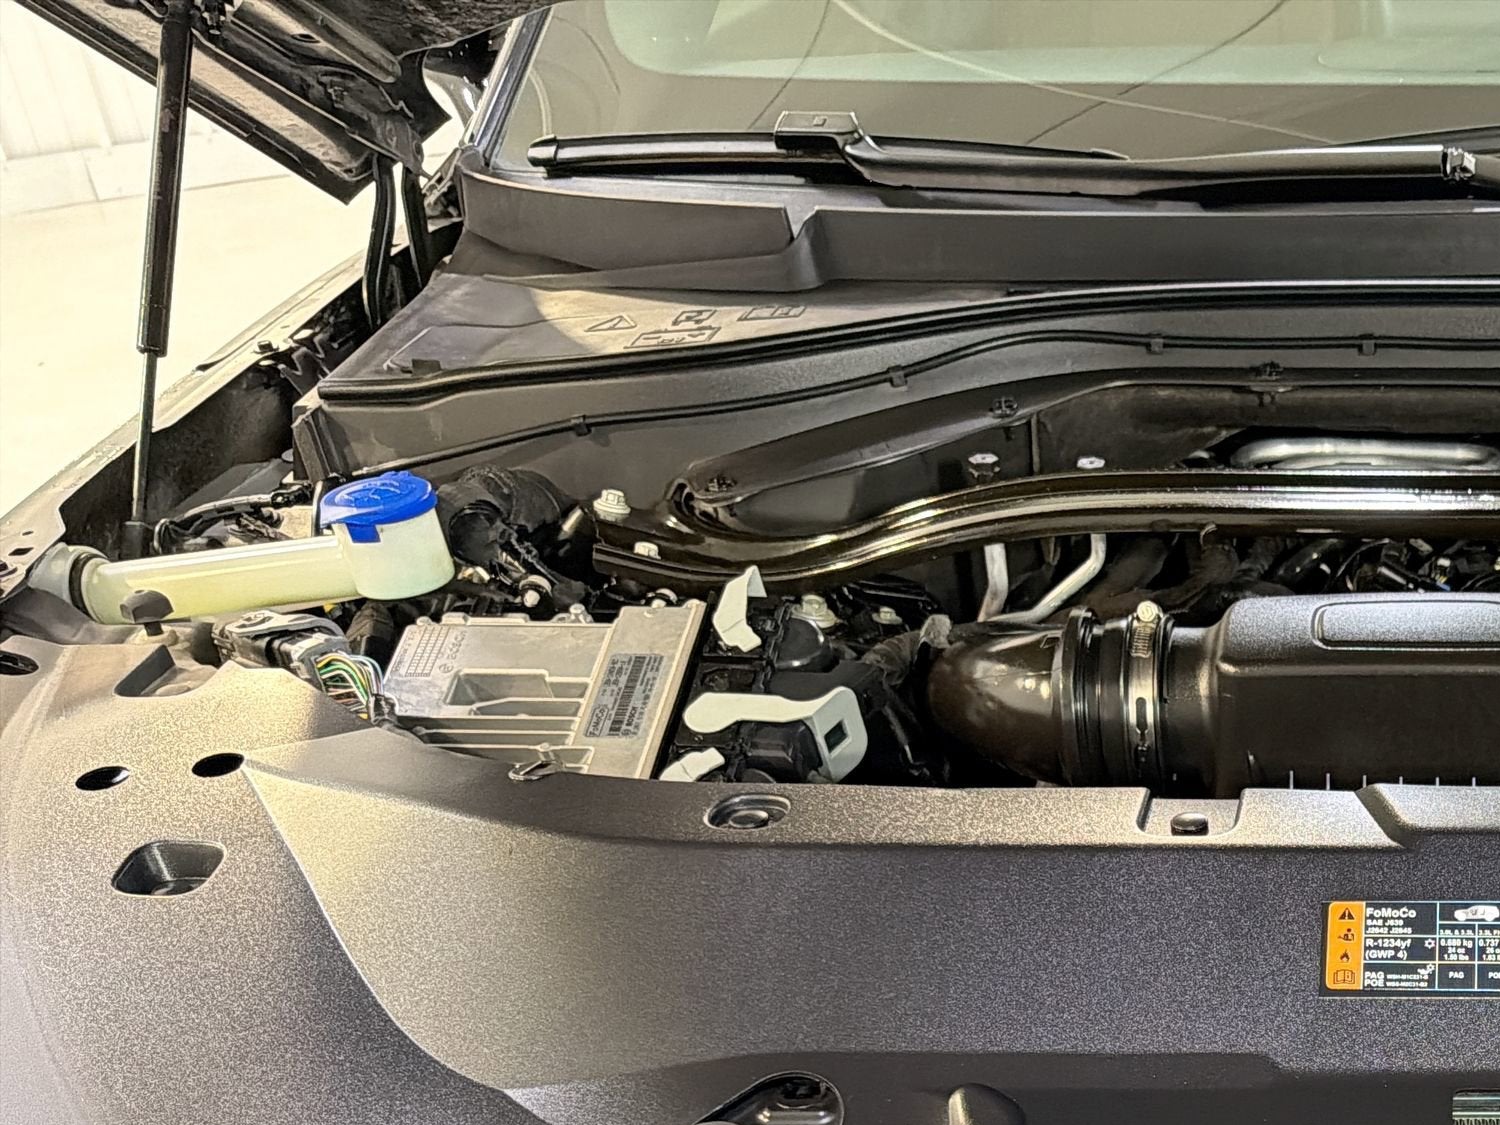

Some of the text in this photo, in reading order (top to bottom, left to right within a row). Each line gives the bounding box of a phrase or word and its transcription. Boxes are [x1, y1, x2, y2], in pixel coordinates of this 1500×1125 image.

[588, 707, 606, 736] FoMoCo
[625, 706, 638, 727] BOSCH
[1366, 906, 1417, 918] FoMoCo
[1365, 938, 1411, 950] R-1234yf
[1462, 938, 1473, 949] kg
[1478, 938, 1500, 947] 0.737
[1365, 949, 1408, 961] (GWP 4)
[1364, 971, 1385, 979] PAG
[1448, 971, 1465, 979] PAG
[1364, 979, 1385, 987] POE
